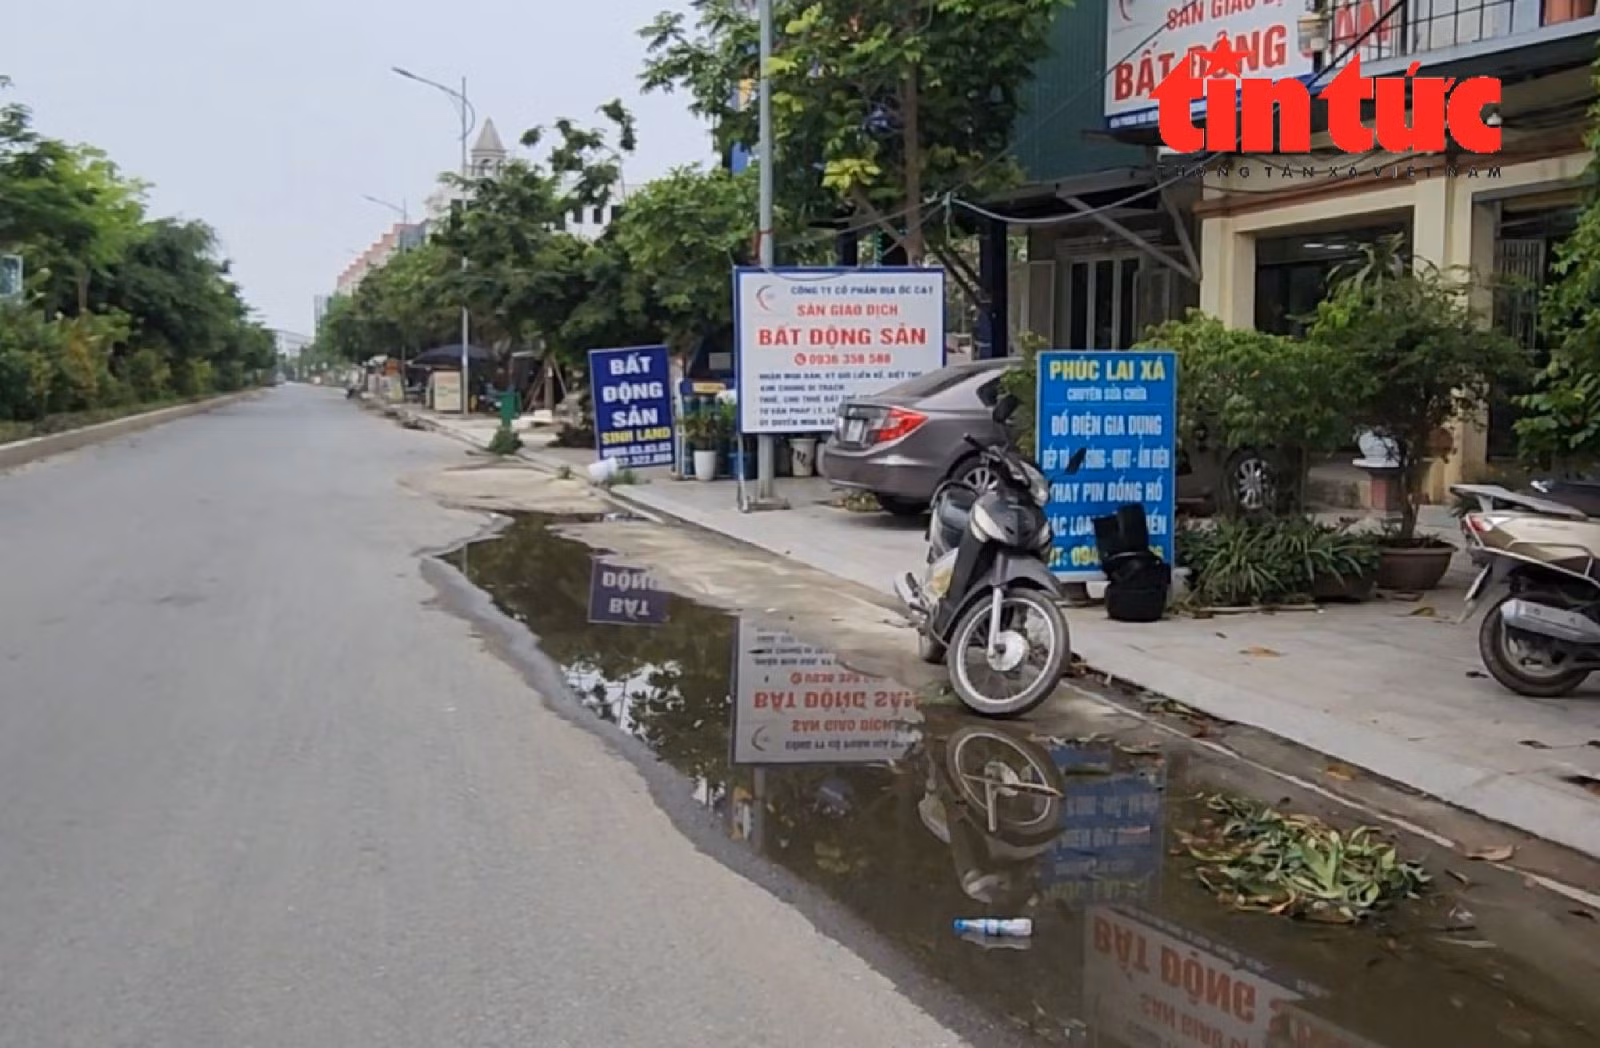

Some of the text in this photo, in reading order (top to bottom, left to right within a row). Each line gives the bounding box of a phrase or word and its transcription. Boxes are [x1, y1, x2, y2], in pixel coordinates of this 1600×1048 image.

[830, 304, 862, 317] GIAO
[758, 321, 926, 350] BẤT ĐỘNG SẢN
[609, 352, 653, 375] BẤT
[1050, 355, 1166, 381] PHÚC LAI XÁ
[602, 381, 664, 405] ĐỘNG
[612, 405, 658, 428] SẢN
[1051, 409, 1162, 440] ĐỒ ĐIỆN GIA DỤNG
[636, 427, 672, 441] LAND
[1107, 475, 1143, 502] ĐỒNG
